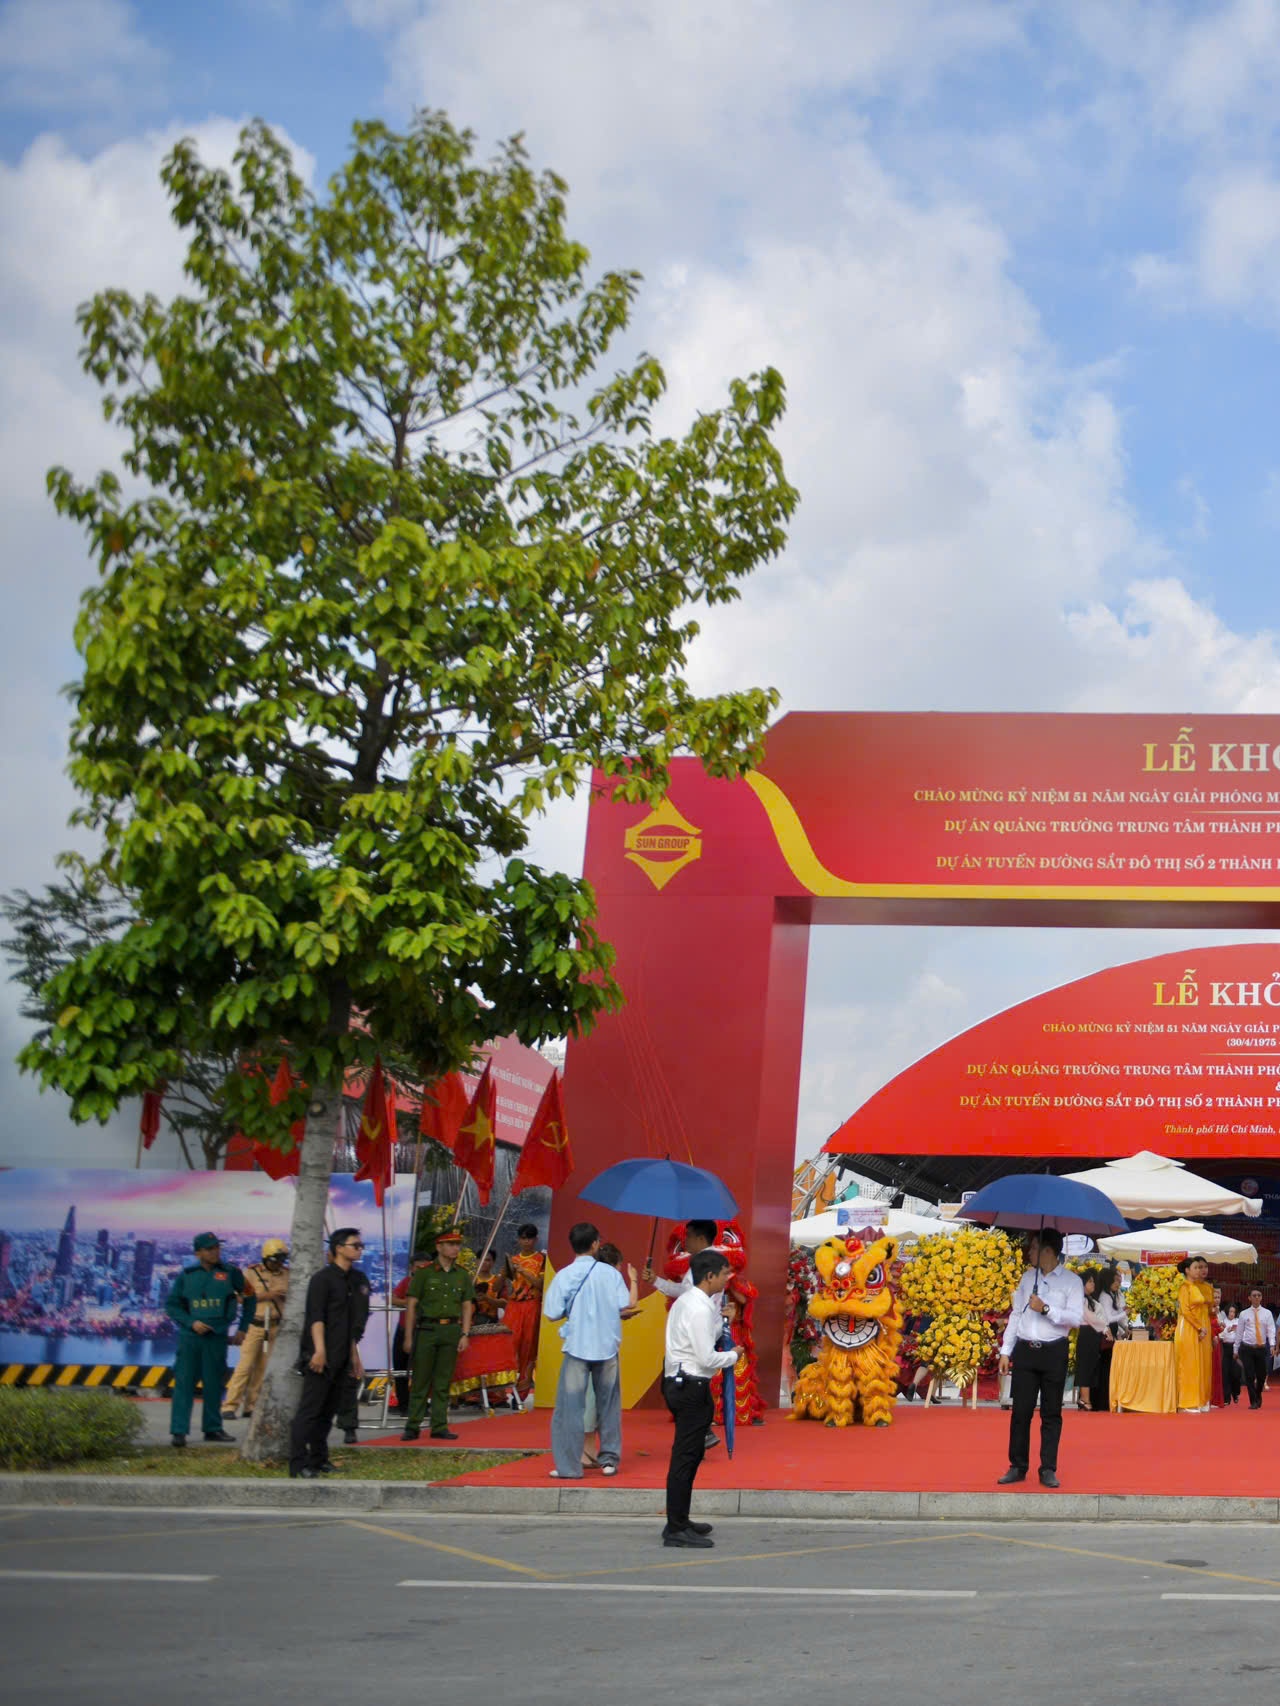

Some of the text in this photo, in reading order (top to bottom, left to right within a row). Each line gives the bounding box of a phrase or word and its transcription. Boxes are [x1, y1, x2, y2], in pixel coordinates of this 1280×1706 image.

[1142, 727, 1195, 772] LỄ
[914, 787, 956, 802] CHÀO
[959, 787, 1004, 802] MỪNG
[1008, 787, 1027, 802] KỶ
[1031, 788, 1070, 805] NIỆM
[1073, 792, 1087, 802] 51
[1092, 789, 1125, 803] NĂM
[1129, 789, 1170, 803] NGÀY
[1173, 788, 1205, 803] GIẢI
[1210, 789, 1262, 803] PHÓNG
[944, 819, 967, 834] DỰ
[969, 818, 990, 832] ÁN
[993, 817, 1046, 834] QUẢNG
[1050, 817, 1113, 832] TRƯỜNG
[1117, 821, 1169, 832] TRUNG
[1173, 819, 1205, 833] TÂM
[1209, 819, 1261, 833] THÀNH
[635, 838, 690, 848] SUN GROUP
[936, 856, 959, 871] DỰ
[961, 854, 982, 868] ÁN
[985, 853, 1036, 868] TUYẾN
[1039, 853, 1093, 869] ĐƯỜNG
[1097, 853, 1126, 869] SẮT
[1129, 855, 1151, 869] ĐÔ
[1154, 858, 1181, 872] THỊ
[1184, 854, 1205, 870] SỐ
[1208, 859, 1216, 869] 2
[1219, 856, 1272, 870] THÀNH
[1153, 969, 1198, 1006] LỄ
[1043, 1022, 1075, 1032] CHÀO
[1078, 1022, 1113, 1032] MỪNG
[1116, 1021, 1131, 1032] KỶ
[1134, 1022, 1164, 1035] NIỆM
[1167, 1024, 1178, 1032] 51
[1182, 1023, 1207, 1033] NĂM
[1210, 1022, 1242, 1033] NGÀY
[1244, 1021, 1269, 1033] GIẢI
[1227, 1038, 1276, 1047] (30/4/1975
[967, 1064, 987, 1076] DỰ
[990, 1062, 1008, 1074] ÁN
[1012, 1061, 1060, 1076] QUẢNG
[1063, 1062, 1120, 1075] TRƯỜNG
[1123, 1065, 1171, 1075] TRUNG
[1174, 1063, 1203, 1075] TÂM
[1206, 1063, 1254, 1075] THÀNH
[960, 1096, 980, 1108] DỰ
[982, 1094, 1001, 1106] ÁN
[1005, 1093, 1050, 1106] TUYẾN
[1054, 1093, 1103, 1107] ĐƯỜNG
[1106, 1092, 1132, 1107] SẮT
[1135, 1094, 1154, 1107] ĐÔ
[1157, 1097, 1181, 1109] THỊ
[1185, 1093, 1203, 1107] SỐ
[1205, 1097, 1213, 1107] 2
[1216, 1094, 1263, 1107] THÀNH
[1165, 1125, 1194, 1133] Thành
[1196, 1124, 1215, 1135] phố
[1215, 1124, 1229, 1133] Hồ
[1231, 1125, 1248, 1133] Chí
[1249, 1125, 1276, 1134] Minh,
